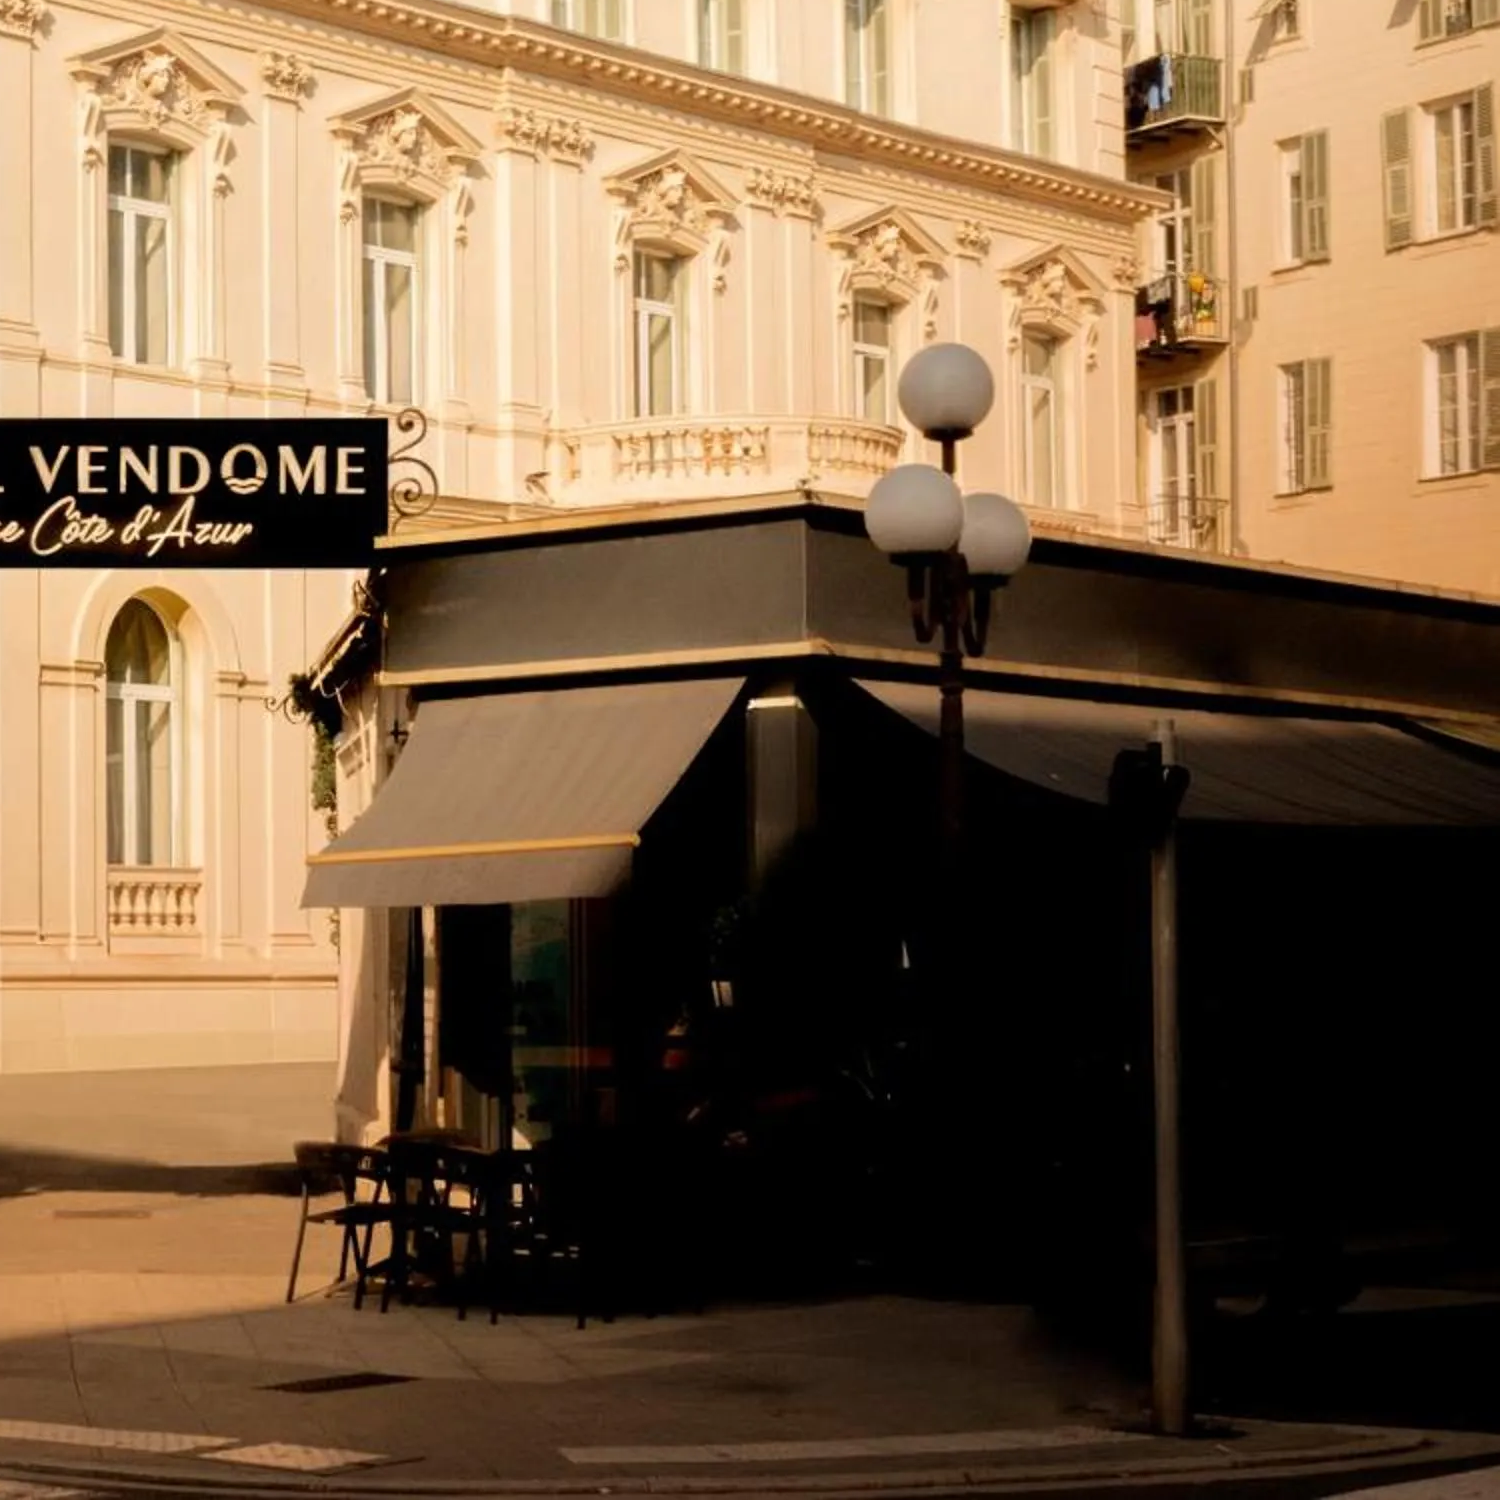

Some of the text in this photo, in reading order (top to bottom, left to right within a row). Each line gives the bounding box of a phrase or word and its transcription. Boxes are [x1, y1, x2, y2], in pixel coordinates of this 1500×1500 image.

[29, 442, 367, 496] VENDOME
[29, 494, 115, 556] Côte
[119, 493, 254, 557] d'Azur
